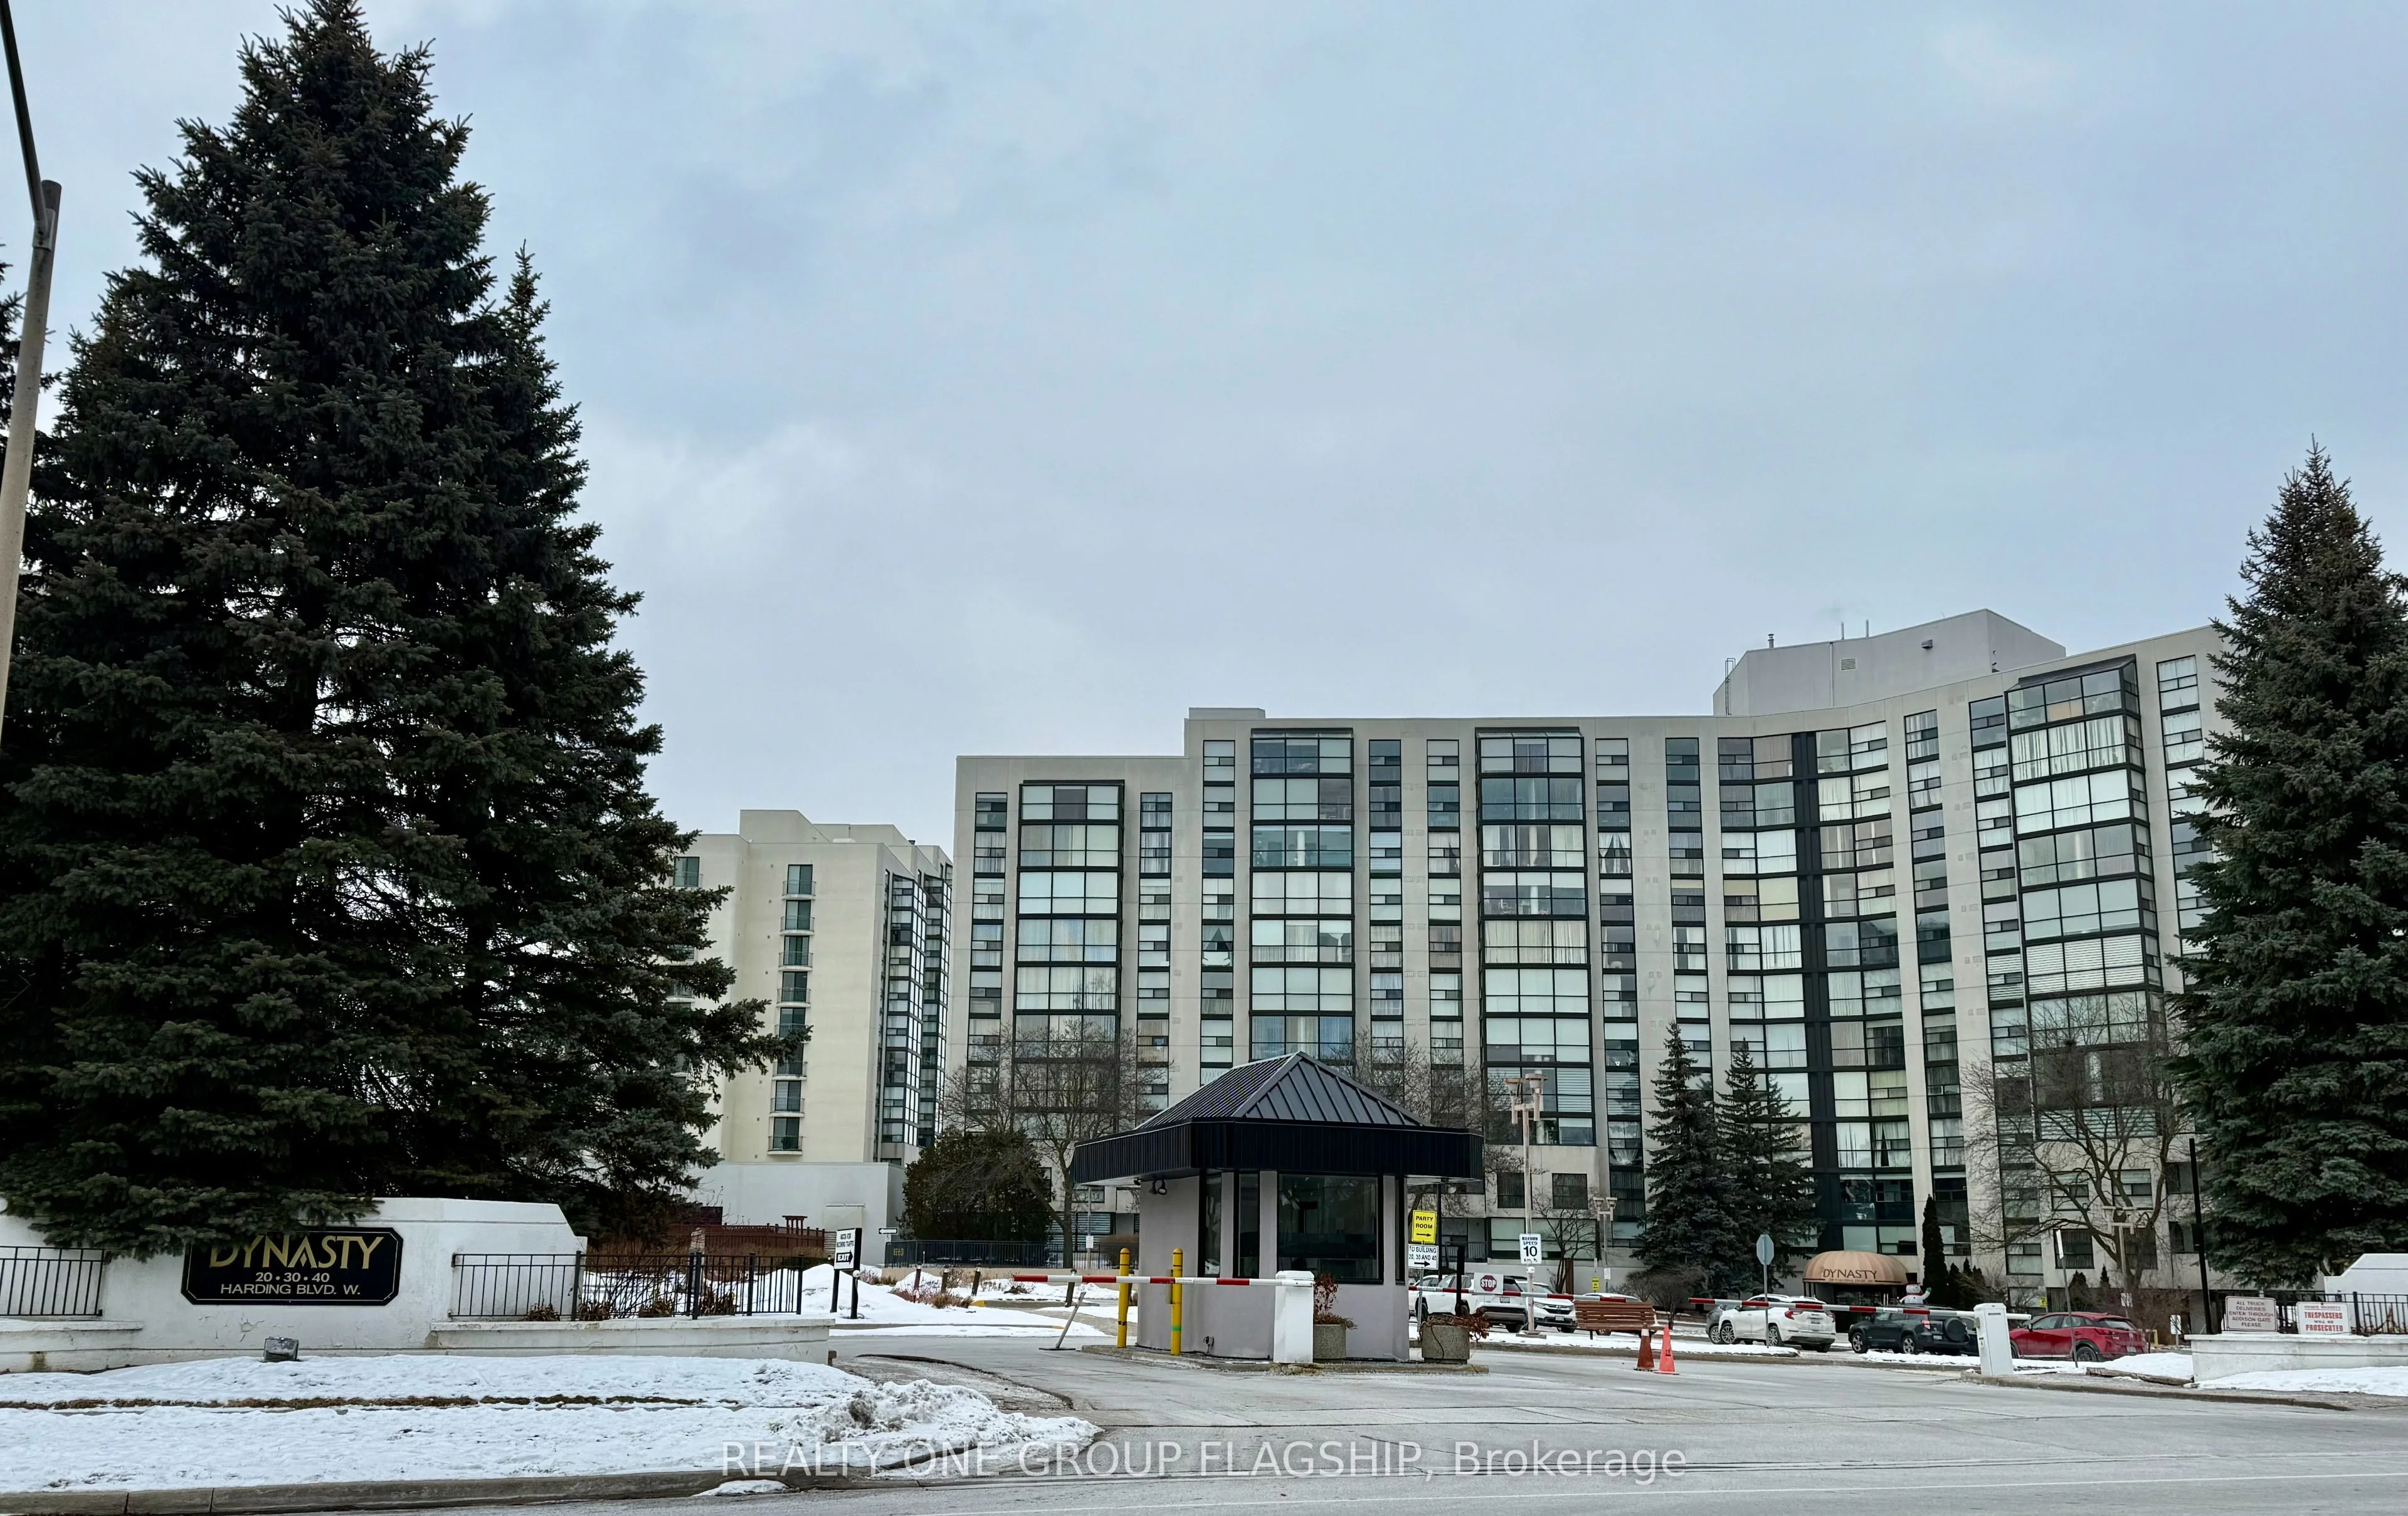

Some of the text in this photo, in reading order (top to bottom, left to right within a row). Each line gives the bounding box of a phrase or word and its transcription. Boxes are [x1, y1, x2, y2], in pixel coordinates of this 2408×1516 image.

[209, 1235, 384, 1269] DYNASTY
[837, 1253, 850, 1261] EXIT
[1523, 1246, 1538, 1257] 10
[255, 1272, 330, 1283] 20 30 40
[1823, 1268, 1876, 1279] DYNASTY
[1481, 1278, 1496, 1288] STOP
[221, 1284, 361, 1295] HARDING BLVD. W.
